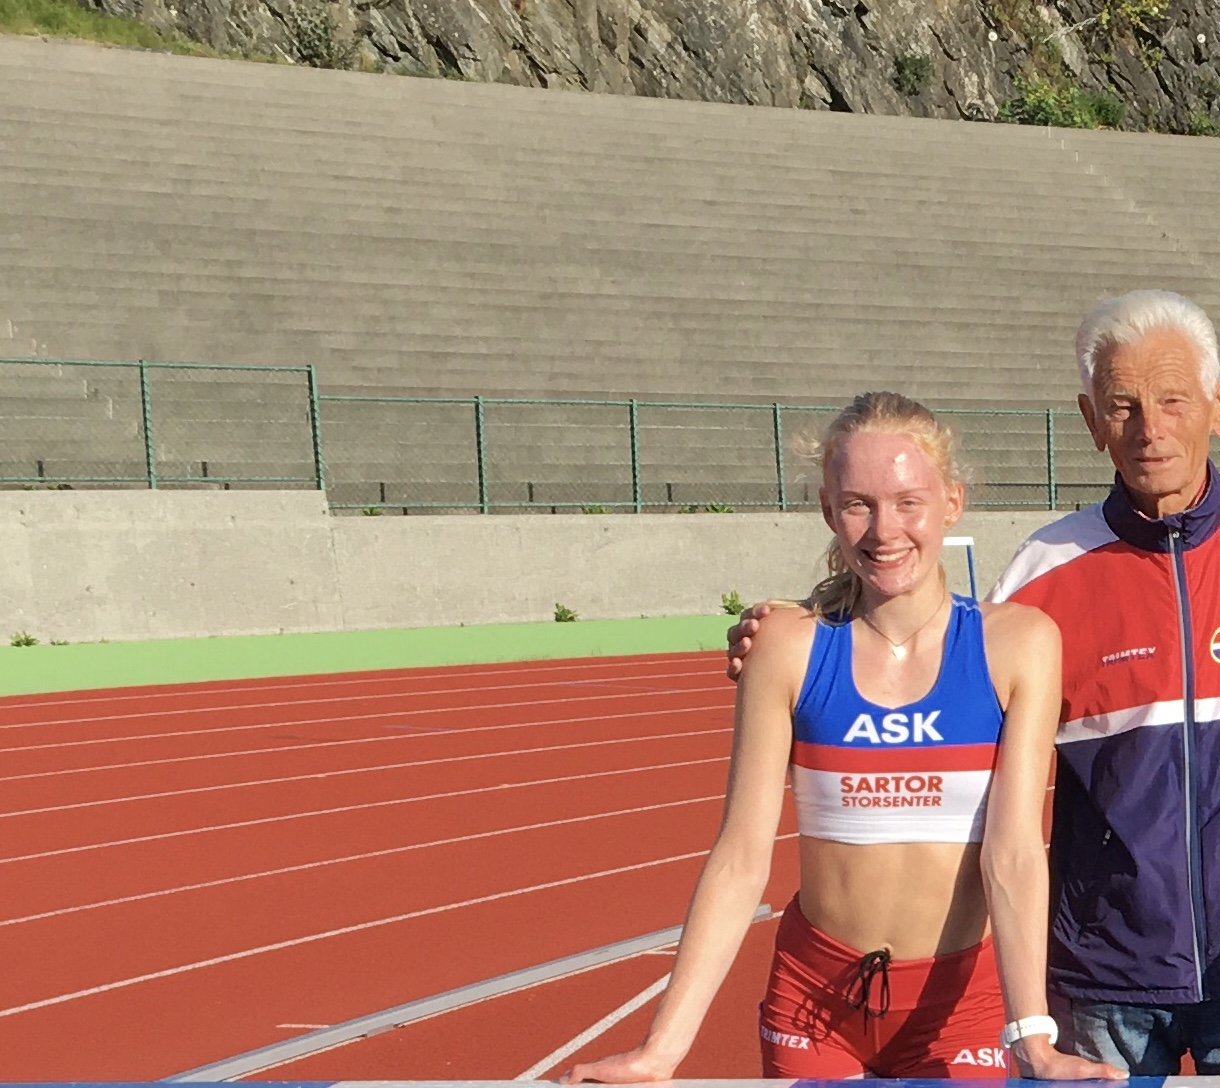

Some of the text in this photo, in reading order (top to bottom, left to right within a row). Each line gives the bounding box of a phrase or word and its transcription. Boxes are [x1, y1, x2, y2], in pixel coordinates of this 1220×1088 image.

[843, 710, 944, 743] ASK
[840, 775, 943, 793] SARTOR
[841, 795, 942, 807] STORSENTER
[950, 1047, 1006, 1069] ASK
